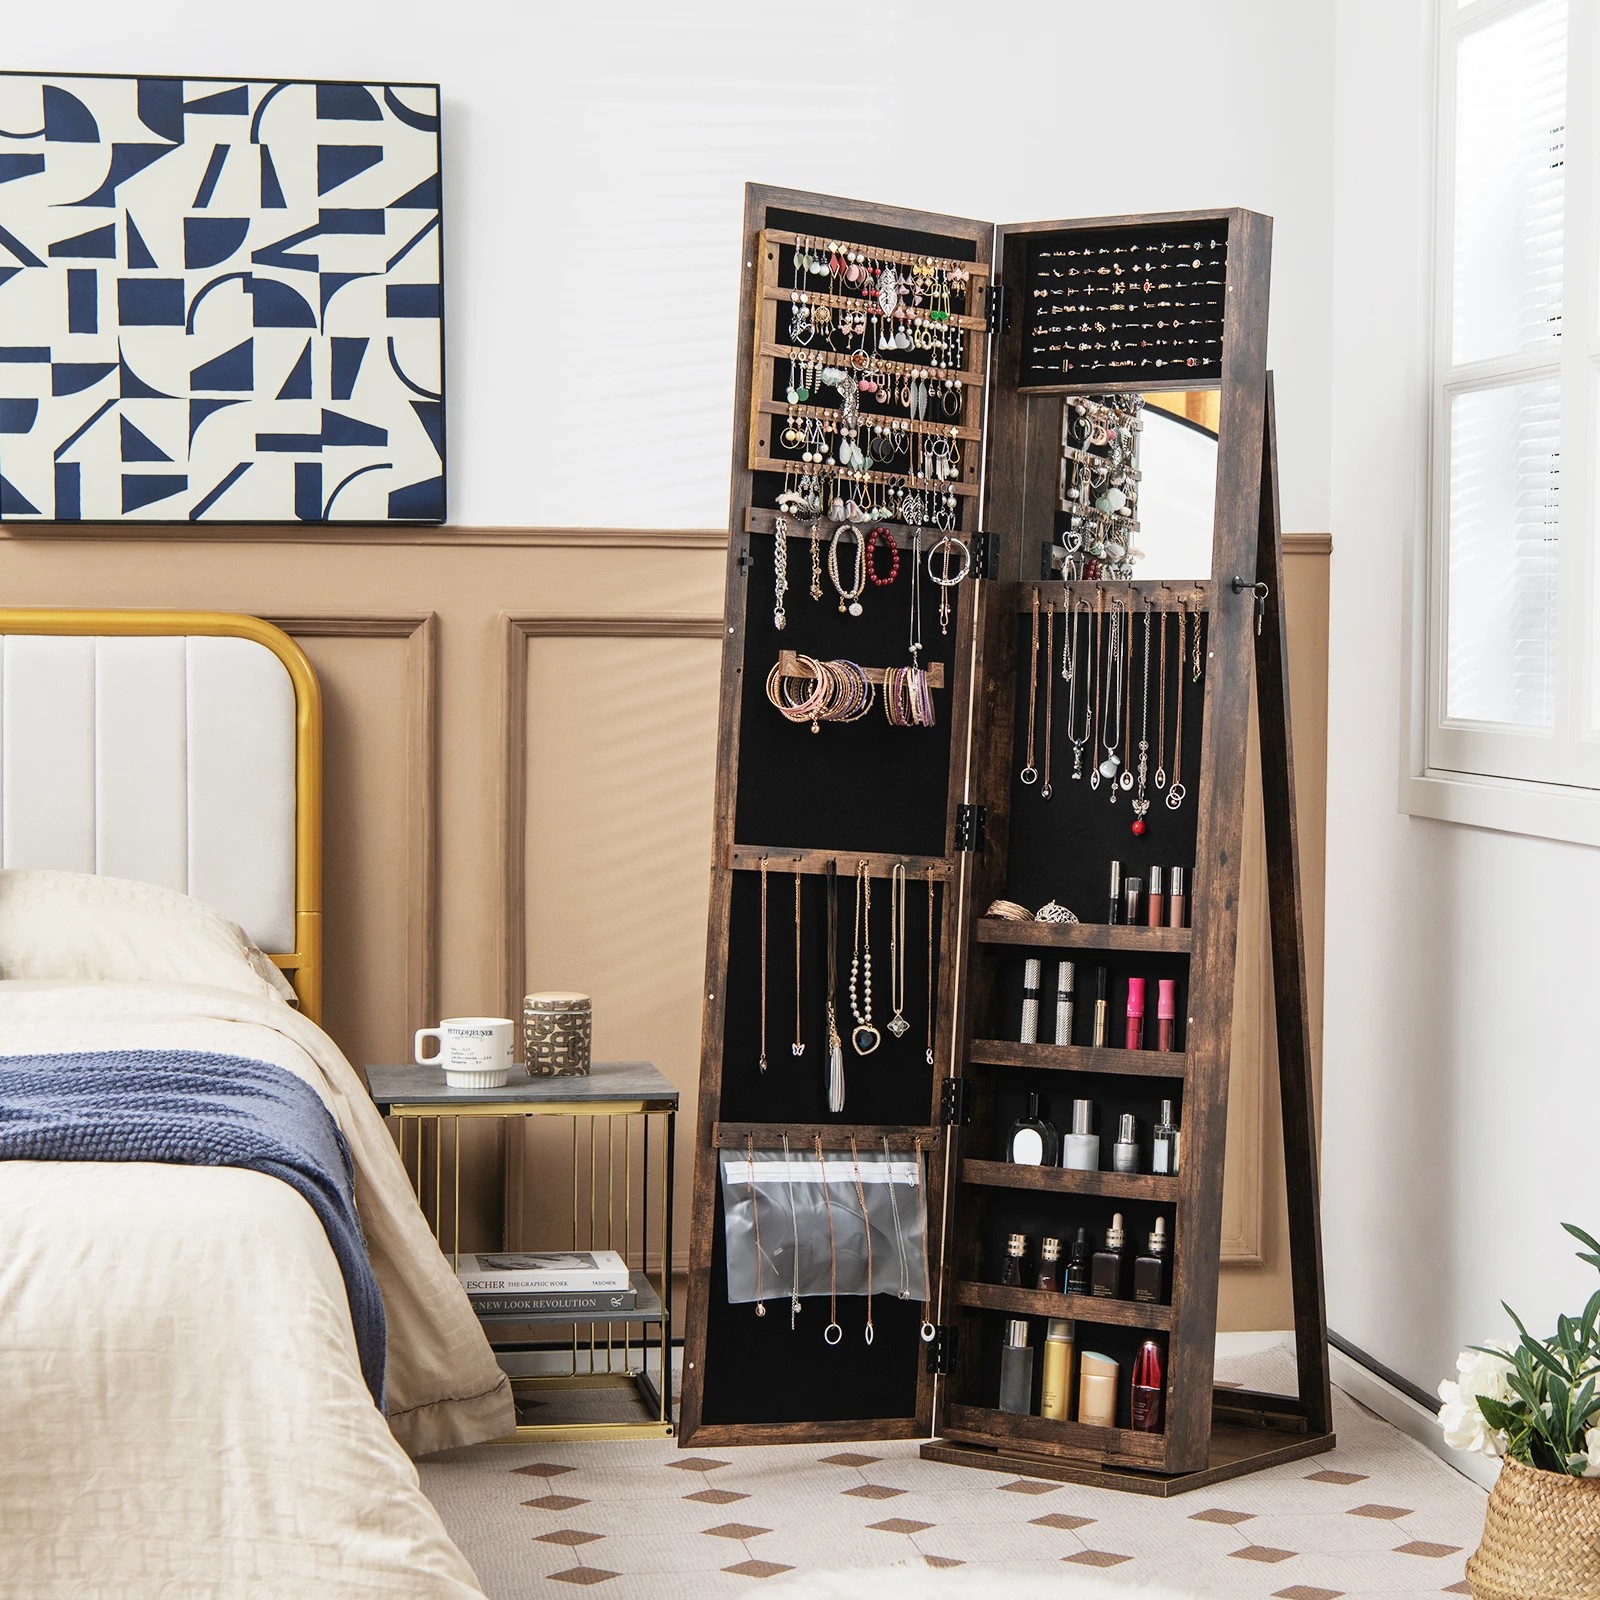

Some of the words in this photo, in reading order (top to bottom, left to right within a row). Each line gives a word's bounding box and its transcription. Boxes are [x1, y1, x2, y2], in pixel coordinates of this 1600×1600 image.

[466, 1280, 505, 1289] ESCHER
[479, 1301, 502, 1310] NEW
[504, 1300, 530, 1309] LOOK
[533, 1299, 596, 1308] REVOLUTION
